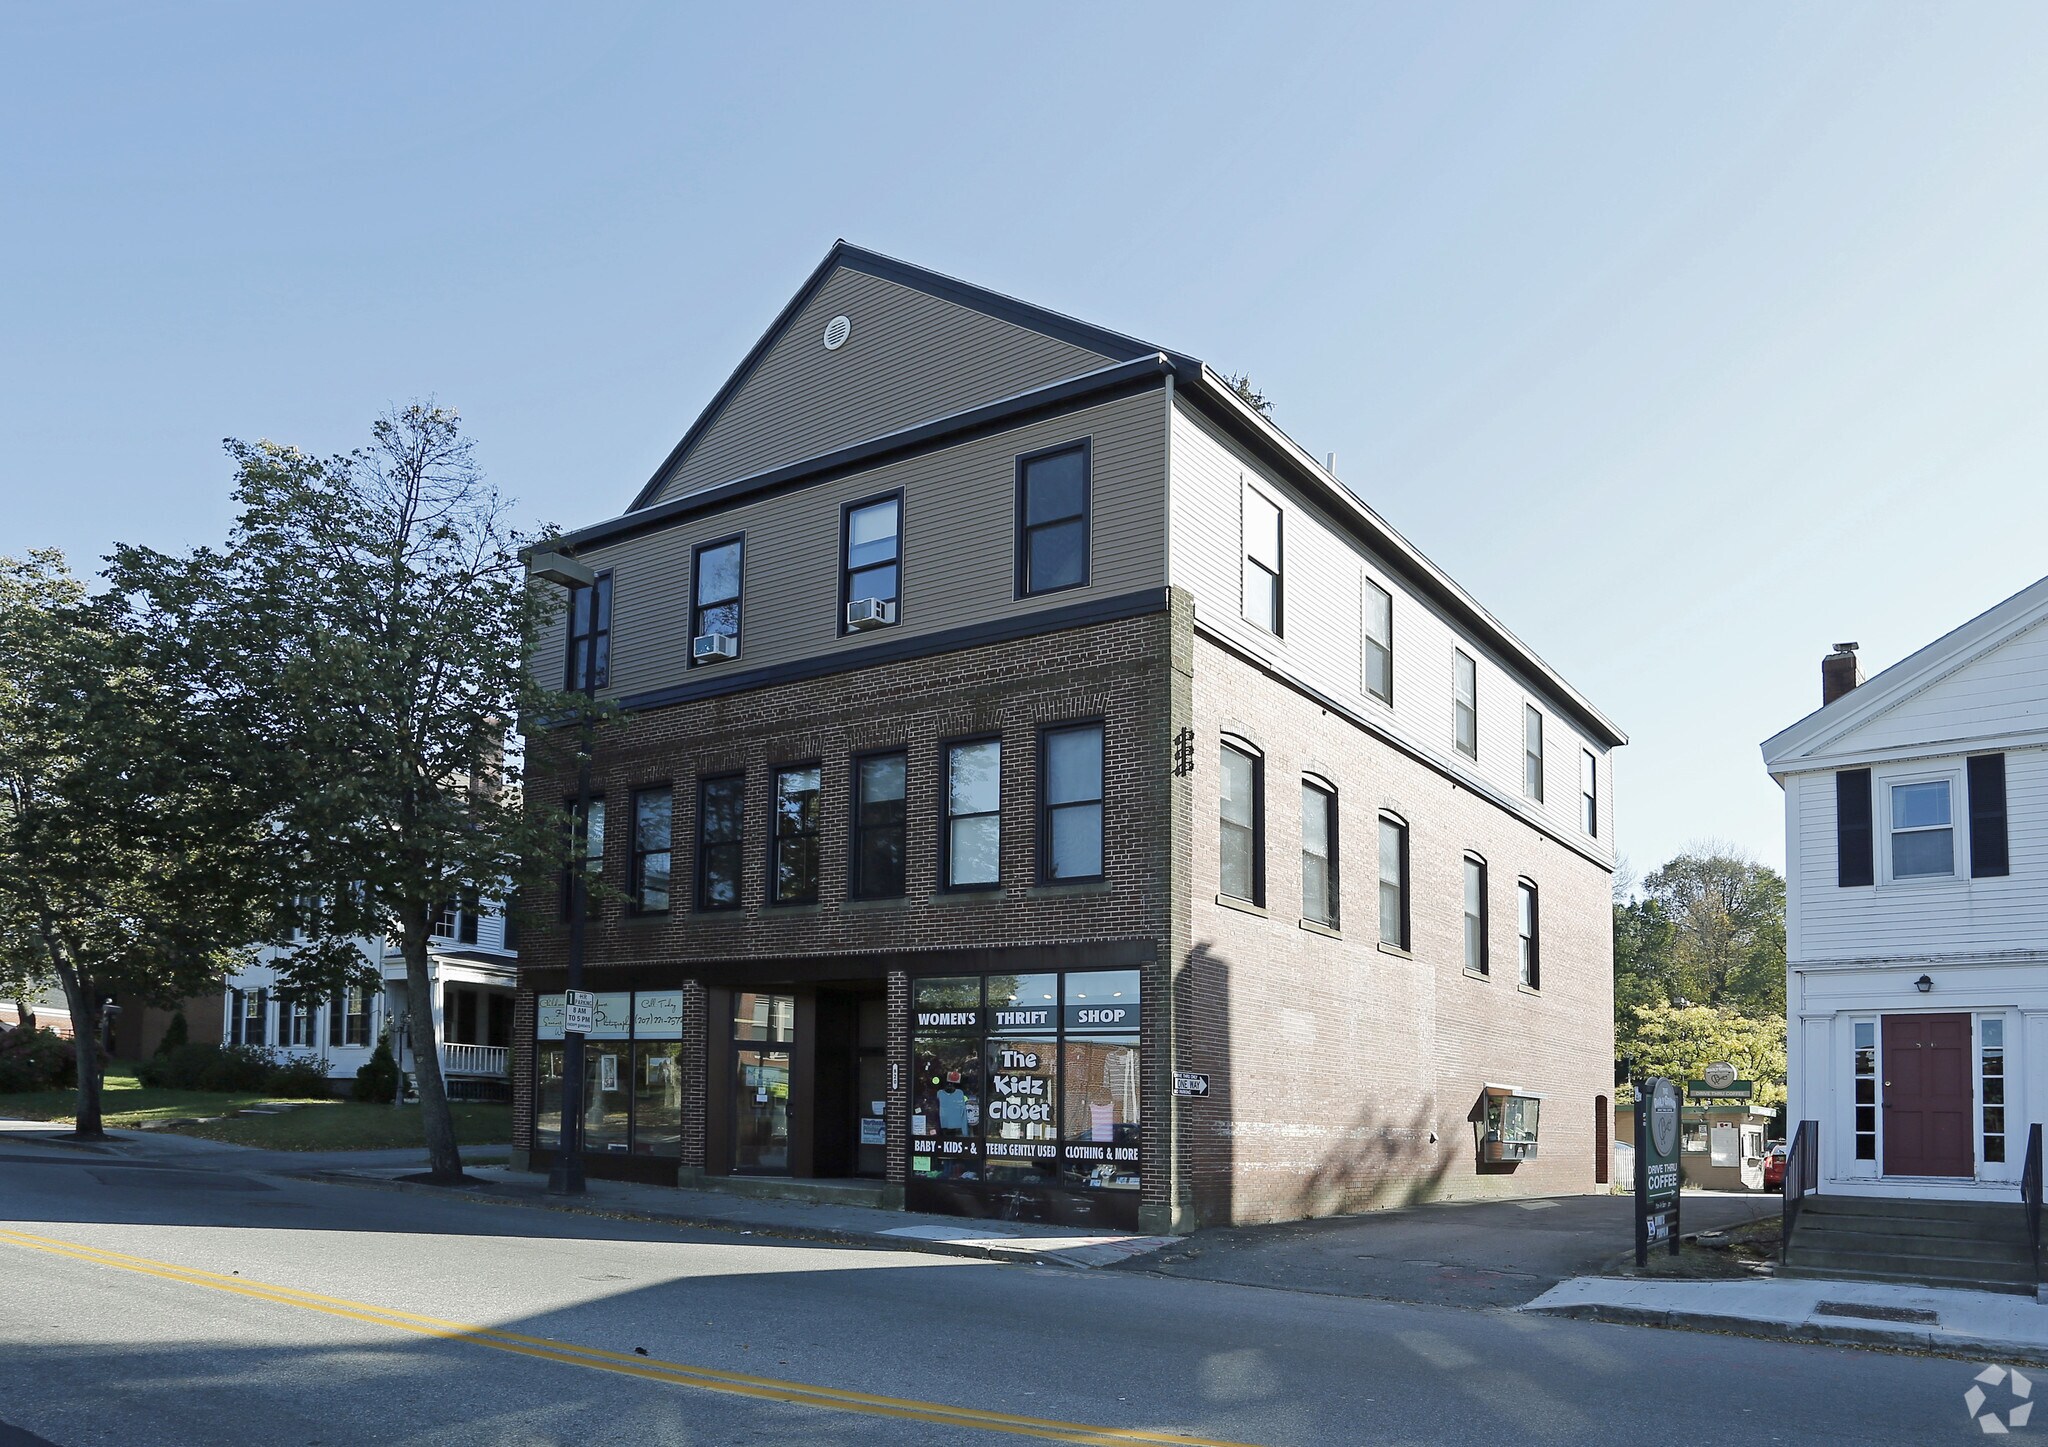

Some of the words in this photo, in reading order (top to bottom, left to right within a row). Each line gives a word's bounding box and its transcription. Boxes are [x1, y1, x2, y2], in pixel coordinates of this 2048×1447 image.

[569, 992, 573, 1005] 1
[568, 1014, 576, 1022] TO
[573, 1006, 577, 1014] 8
[578, 1007, 587, 1015] AM
[917, 1012, 976, 1026] WOMEN'S
[995, 1010, 1048, 1026] THRIFT
[1078, 1009, 1126, 1024] SHOP
[1001, 1050, 1038, 1069] The
[993, 1075, 1044, 1096] Kidz
[1177, 1079, 1188, 1090] ONE
[1189, 1080, 1201, 1091] WAY
[989, 1100, 1051, 1121] Closet
[914, 1140, 937, 1152] BABY
[943, 1141, 963, 1154] KIDS
[970, 1142, 978, 1155] &
[986, 1143, 1008, 1157] TEENS
[1008, 1143, 1036, 1158] GENTLY
[1037, 1145, 1057, 1158] USED
[1065, 1145, 1104, 1159] CLOTHING
[1106, 1147, 1114, 1161] &
[1114, 1147, 1139, 1161] MORE
[1647, 1164, 1664, 1175] DRIVE
[1664, 1162, 1678, 1173] THRU
[1648, 1173, 1678, 1191] COFFEE
